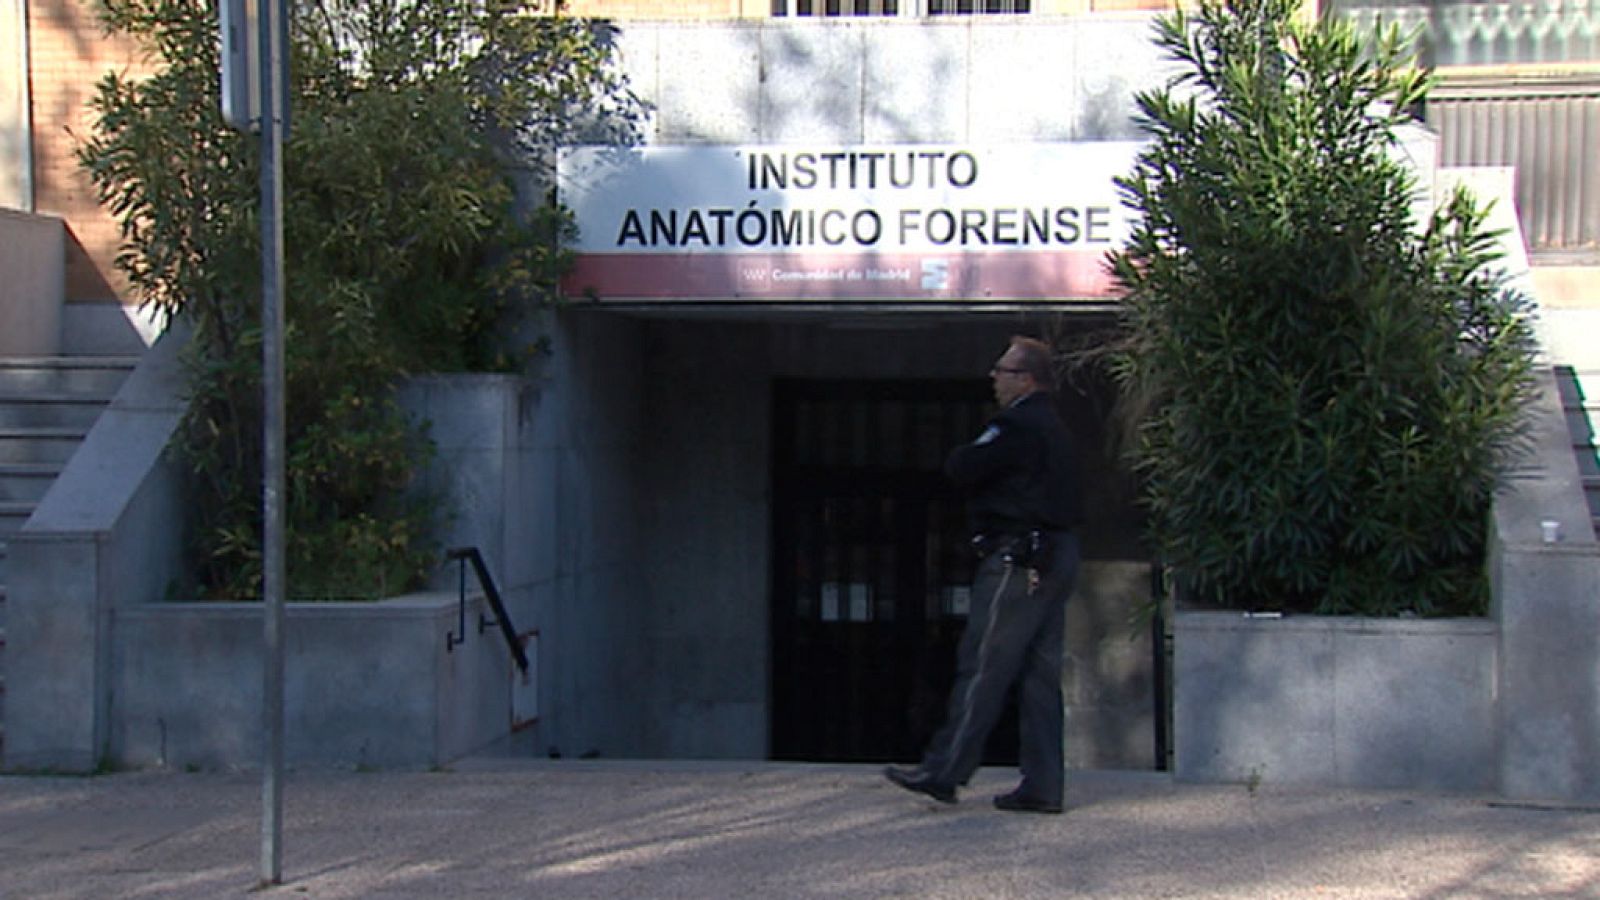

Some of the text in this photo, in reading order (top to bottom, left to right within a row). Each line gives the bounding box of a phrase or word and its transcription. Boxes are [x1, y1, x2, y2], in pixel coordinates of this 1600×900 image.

[748, 151, 978, 190] INSTITUTO
[617, 200, 1111, 247] ANATÓMICO FORENSE
[772, 268, 910, 281] Comunidad de Madrid
